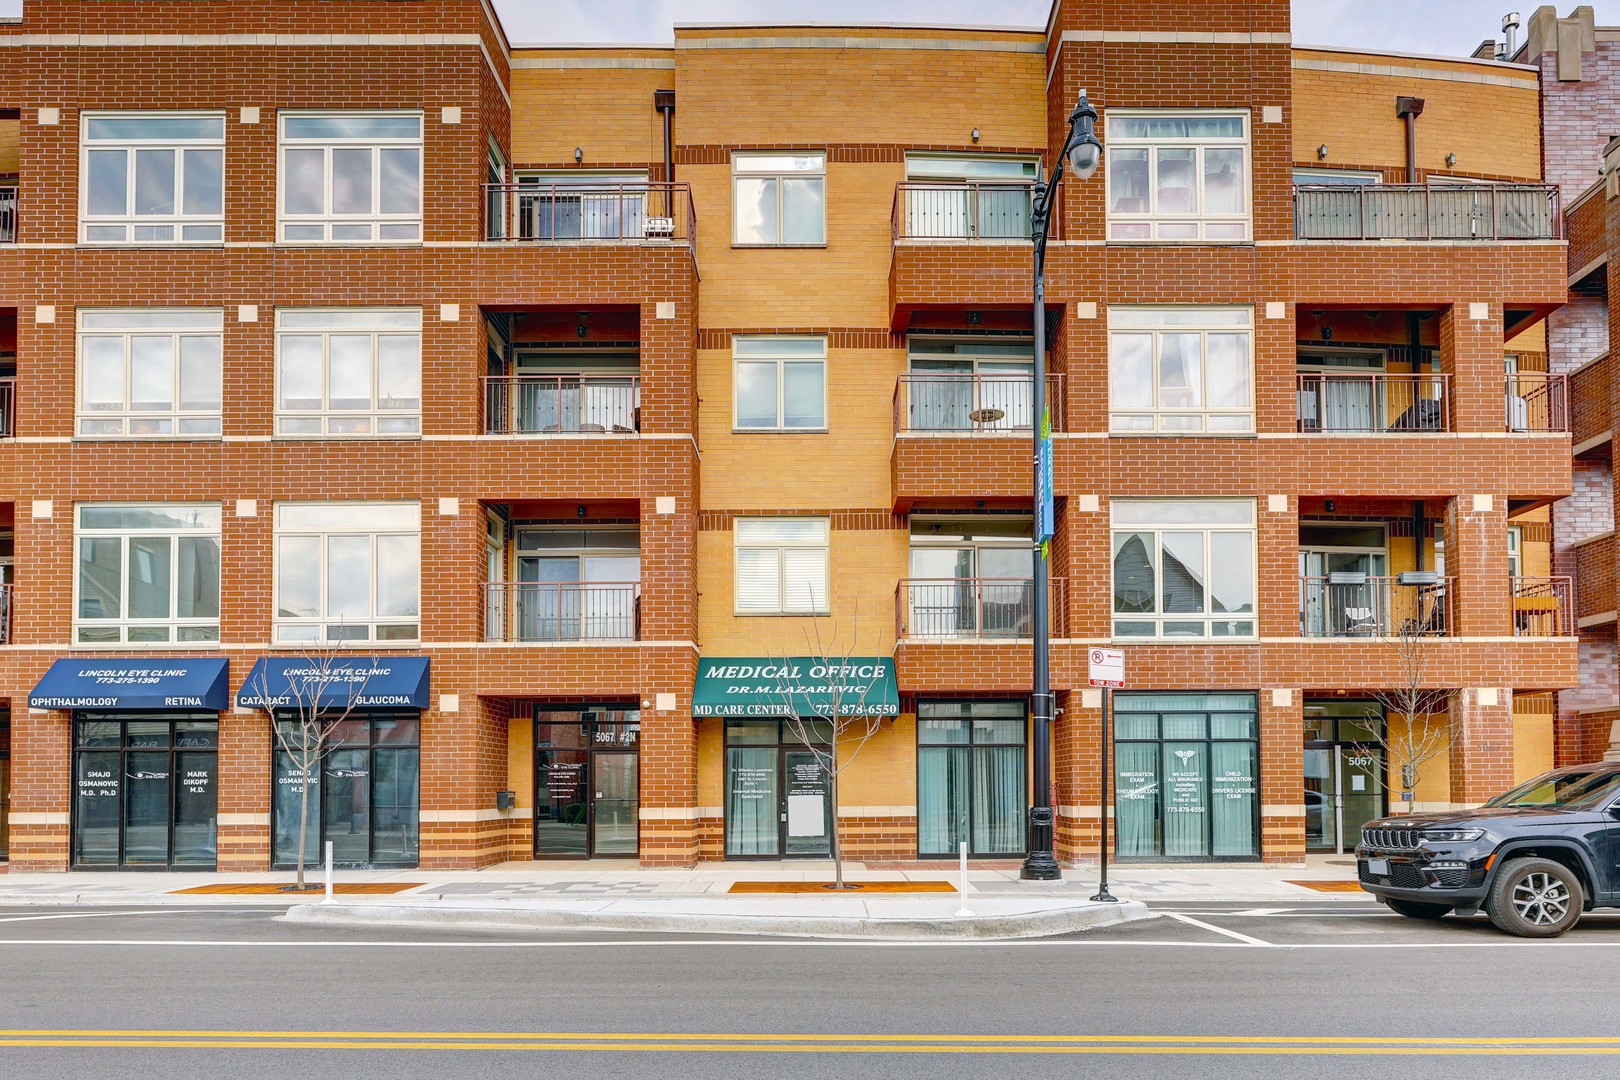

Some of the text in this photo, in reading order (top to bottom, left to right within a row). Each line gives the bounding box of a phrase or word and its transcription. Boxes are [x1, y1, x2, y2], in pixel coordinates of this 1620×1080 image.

[704, 666, 886, 678] MEDICAL OFFICE
[31, 697, 118, 706] OPHTHALMOLOGY
[165, 697, 202, 706] RETINA
[240, 696, 291, 705] CATARACT
[356, 696, 410, 704] GLAUCOMA
[694, 705, 792, 715] MD CARE CENTER
[816, 704, 897, 714] 773-878-6550
[596, 732, 636, 742] 5067 #2N
[1349, 757, 1372, 765] 5067
